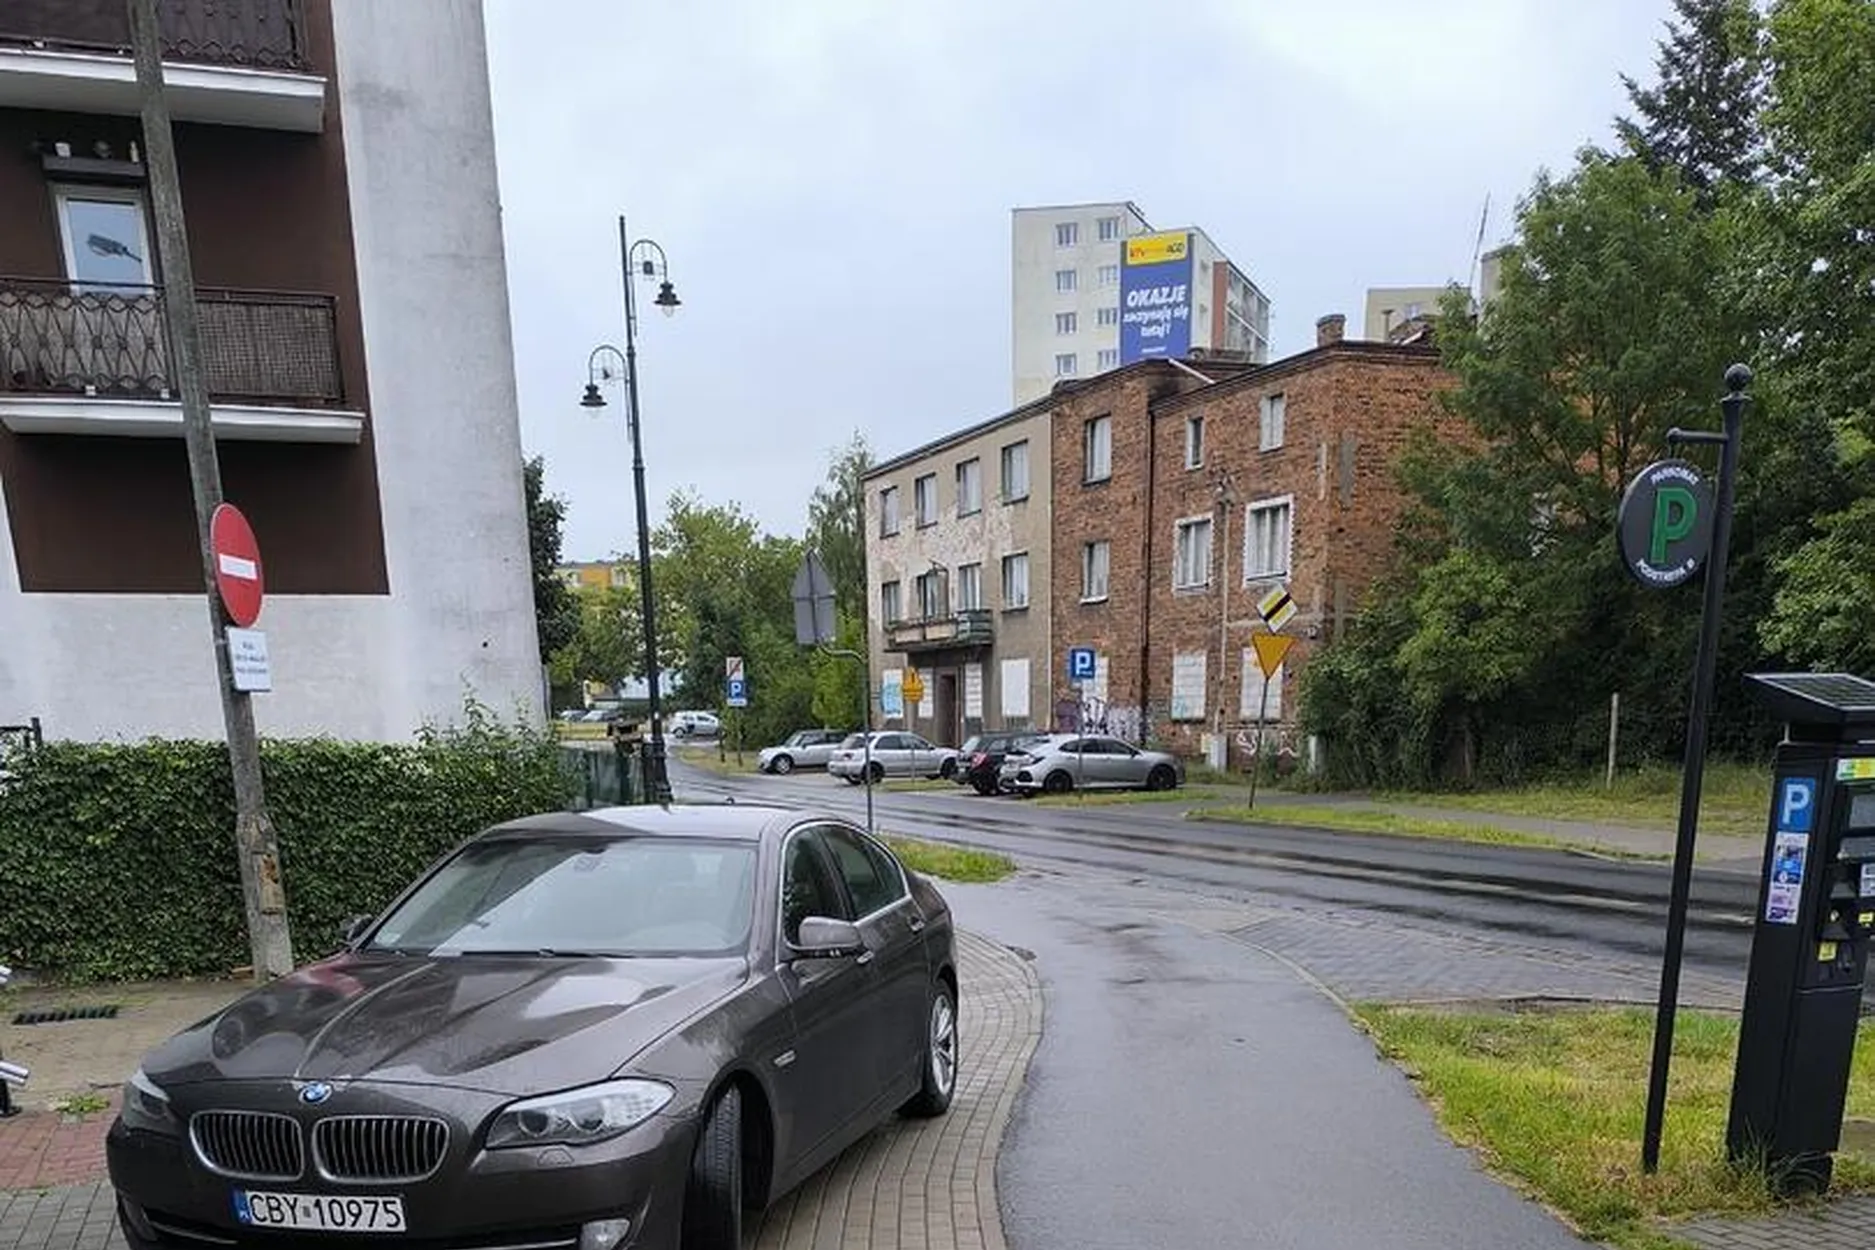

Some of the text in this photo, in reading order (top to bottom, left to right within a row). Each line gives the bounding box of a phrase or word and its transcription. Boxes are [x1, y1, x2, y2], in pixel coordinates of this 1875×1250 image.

[1127, 285, 1187, 307] OKAZJE
[1650, 487, 1697, 564] P
[1076, 652, 1091, 675] P
[731, 682, 742, 697] P
[1782, 784, 1809, 825] P
[250, 1194, 401, 1228] CBY 10975
